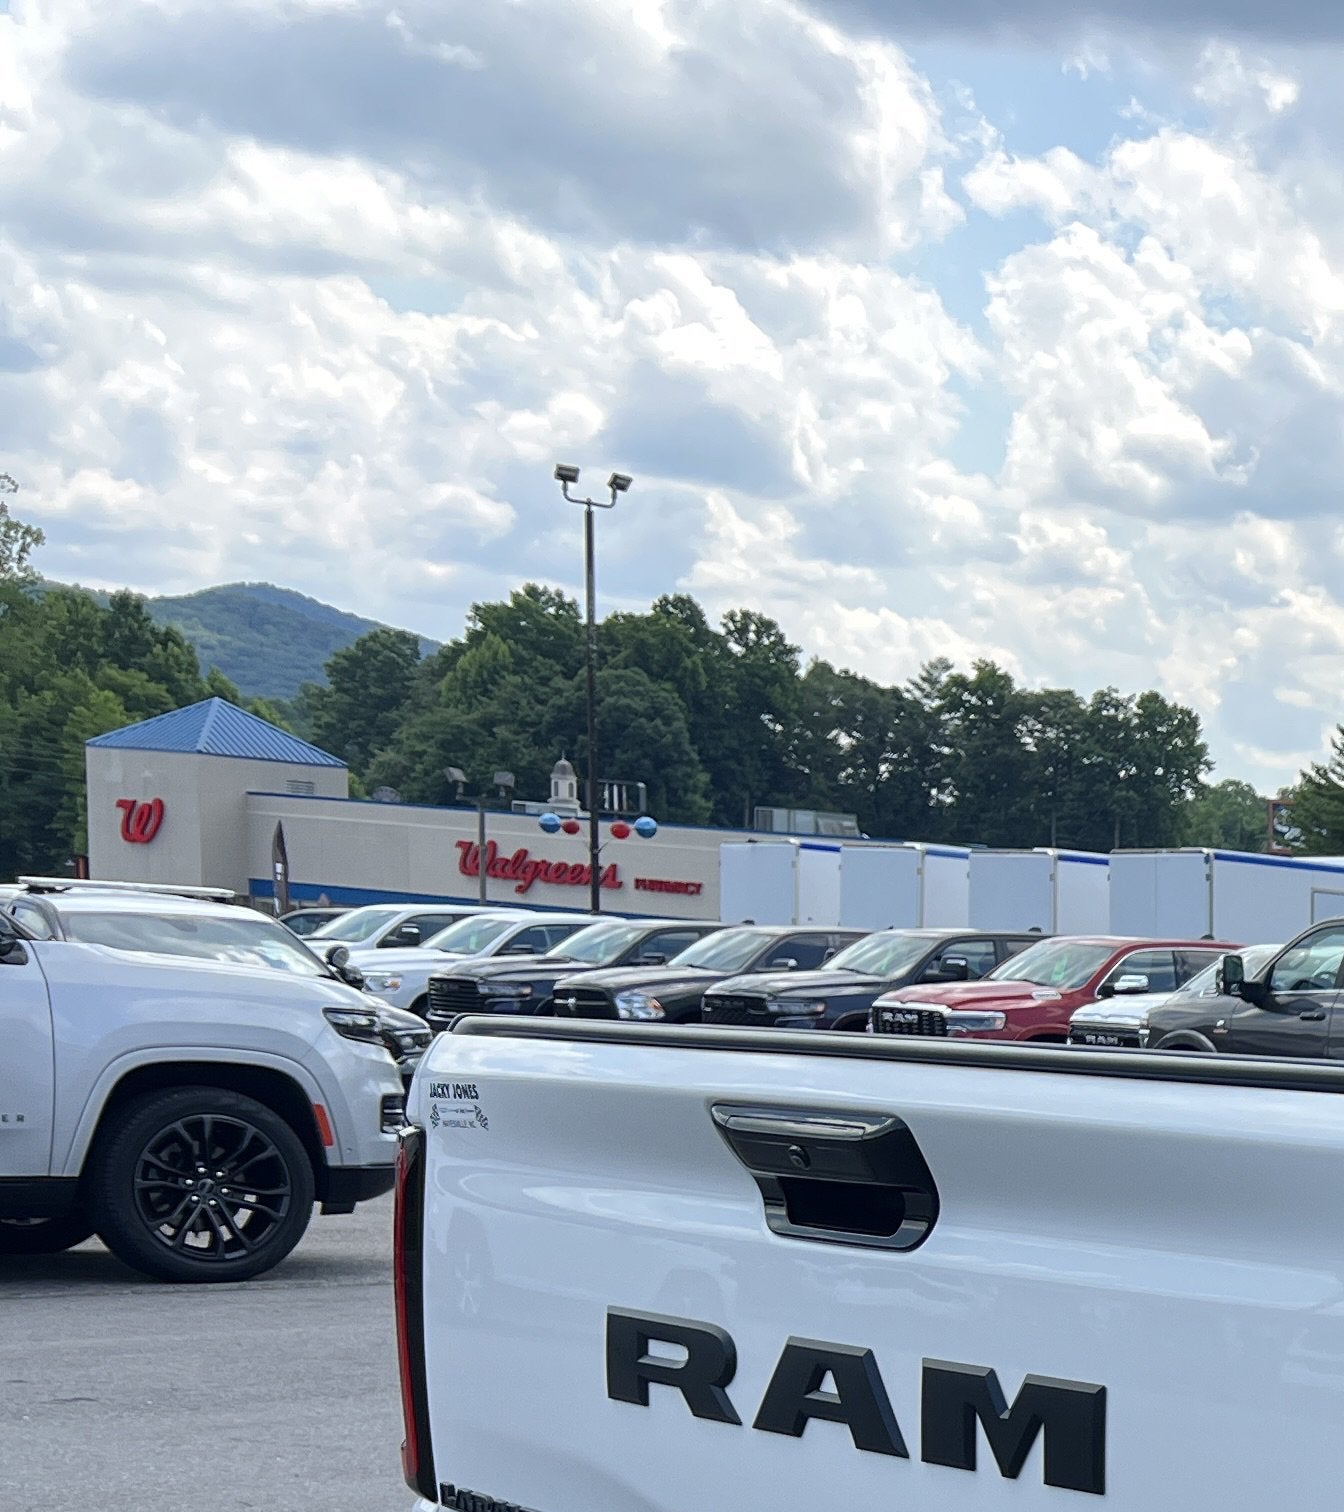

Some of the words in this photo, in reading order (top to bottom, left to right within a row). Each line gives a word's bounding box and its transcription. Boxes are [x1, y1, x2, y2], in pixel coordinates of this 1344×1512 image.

[116, 798, 164, 843] W
[881, 1011, 919, 1024] RAM
[430, 1082, 450, 1099] JACKY
[452, 1083, 479, 1100] JONES
[606, 1305, 1107, 1496] RAM
